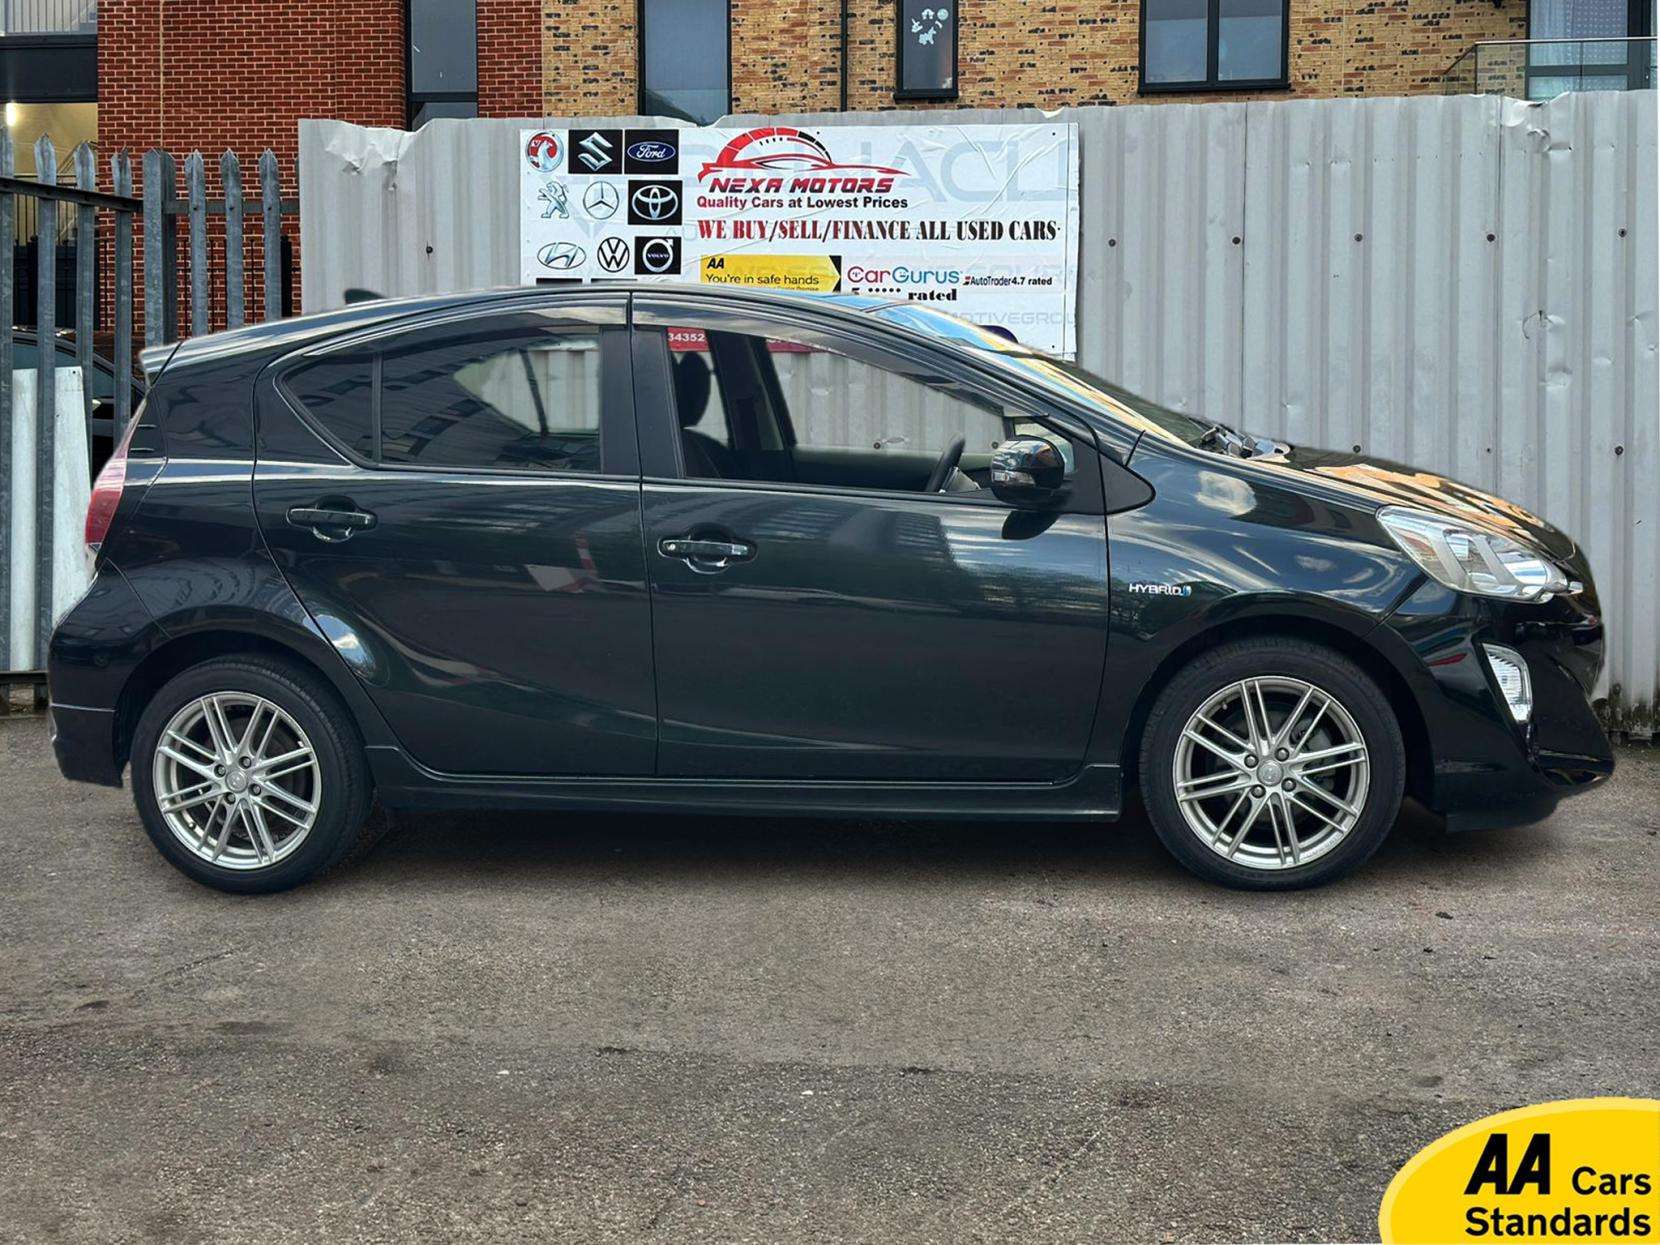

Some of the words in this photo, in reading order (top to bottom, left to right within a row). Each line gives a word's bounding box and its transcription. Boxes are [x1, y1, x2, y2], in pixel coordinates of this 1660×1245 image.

[636, 143, 666, 159] Ford
[708, 178, 784, 194] NEXA
[789, 178, 894, 194] MOTORS
[697, 196, 747, 209] Quality
[752, 196, 784, 208] Cars
[788, 196, 803, 208] at
[807, 196, 859, 208] Lowest
[863, 196, 908, 208] Prices
[698, 219, 727, 240] WE
[733, 219, 911, 242] BUY/SELL/FINANCE
[916, 220, 951, 240] ALL
[956, 220, 1004, 240] USED
[1008, 220, 1057, 240] CARS
[706, 257, 725, 269] AA
[705, 273, 741, 285] You're
[744, 273, 755, 285] in
[757, 273, 781, 285] safe
[783, 273, 820, 285] hands
[847, 266, 960, 284] CarGurus
[1028, 277, 1053, 286] rated
[907, 288, 957, 301] rated
[1128, 583, 1182, 597] HYBRID
